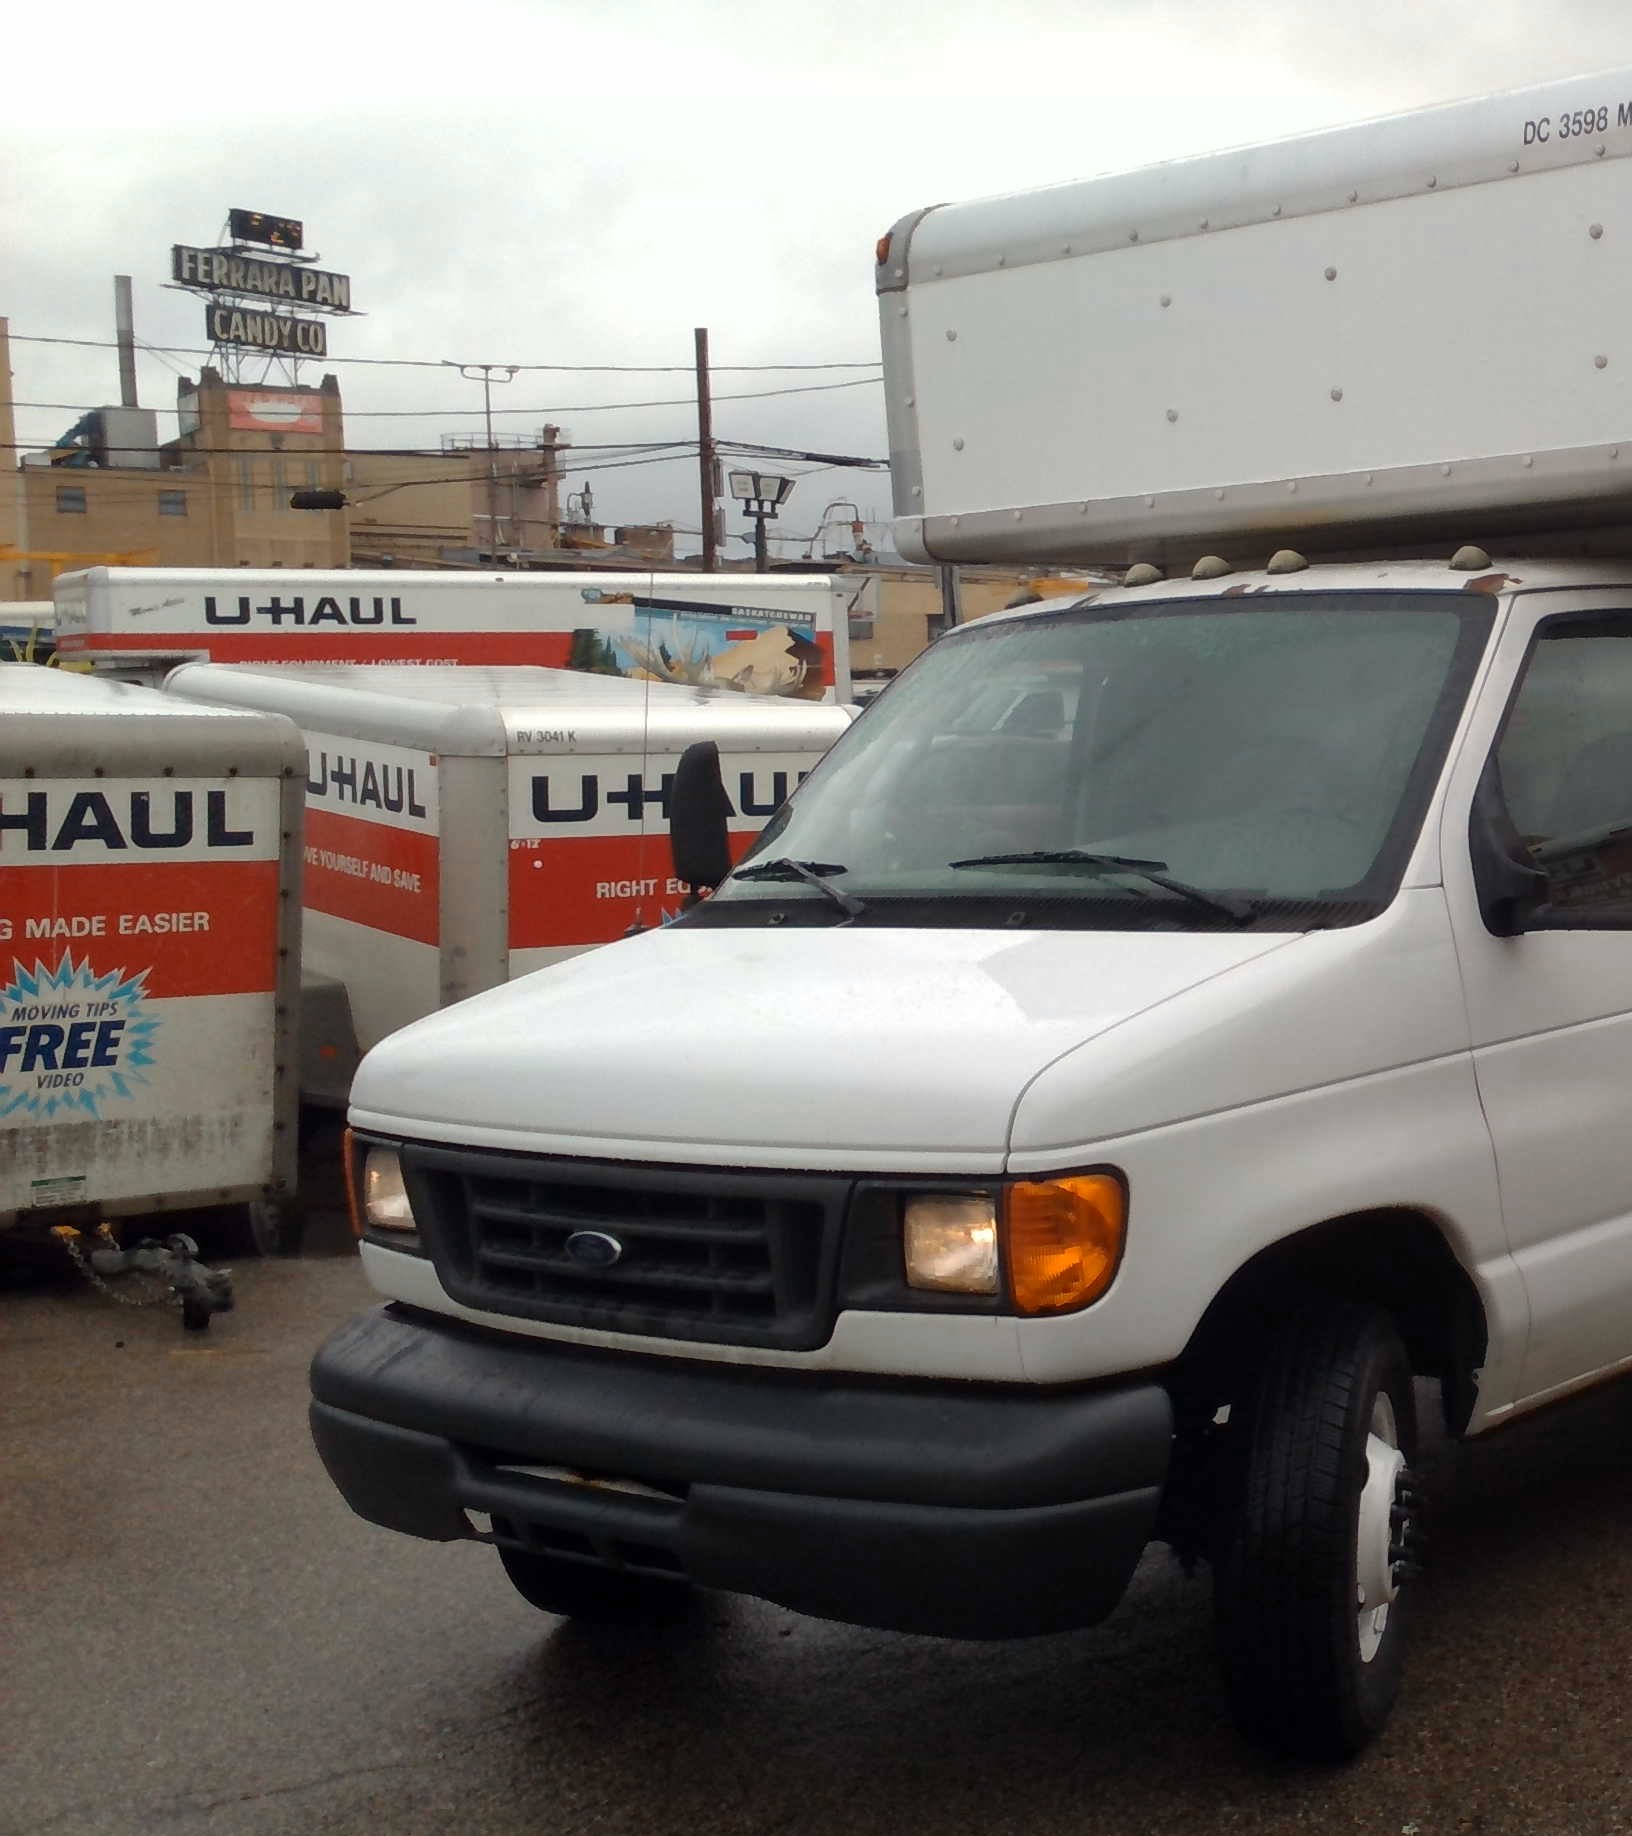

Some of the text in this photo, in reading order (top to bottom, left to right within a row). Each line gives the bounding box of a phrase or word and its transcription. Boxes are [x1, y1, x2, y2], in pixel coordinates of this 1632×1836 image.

[1523, 117, 1551, 145] DC
[1558, 106, 1608, 139] 3598
[181, 248, 350, 308] FERRARA PAN
[213, 309, 324, 353] CANDY CO
[205, 596, 417, 626] U-HAUL
[516, 730, 577, 743] RV 3041 K
[304, 749, 426, 818] U-HAUL
[320, 849, 369, 878] YOURSELF
[370, 862, 391, 885] AND
[393, 868, 421, 894] SAVE
[596, 879, 657, 898] RIGHT
[26, 915, 106, 939] MADE
[119, 911, 210, 935] EASIER
[11, 1001, 118, 1021] MOVING TIPS
[0, 1020, 126, 1074] FREE
[37, 1072, 84, 1088] VIDEO
